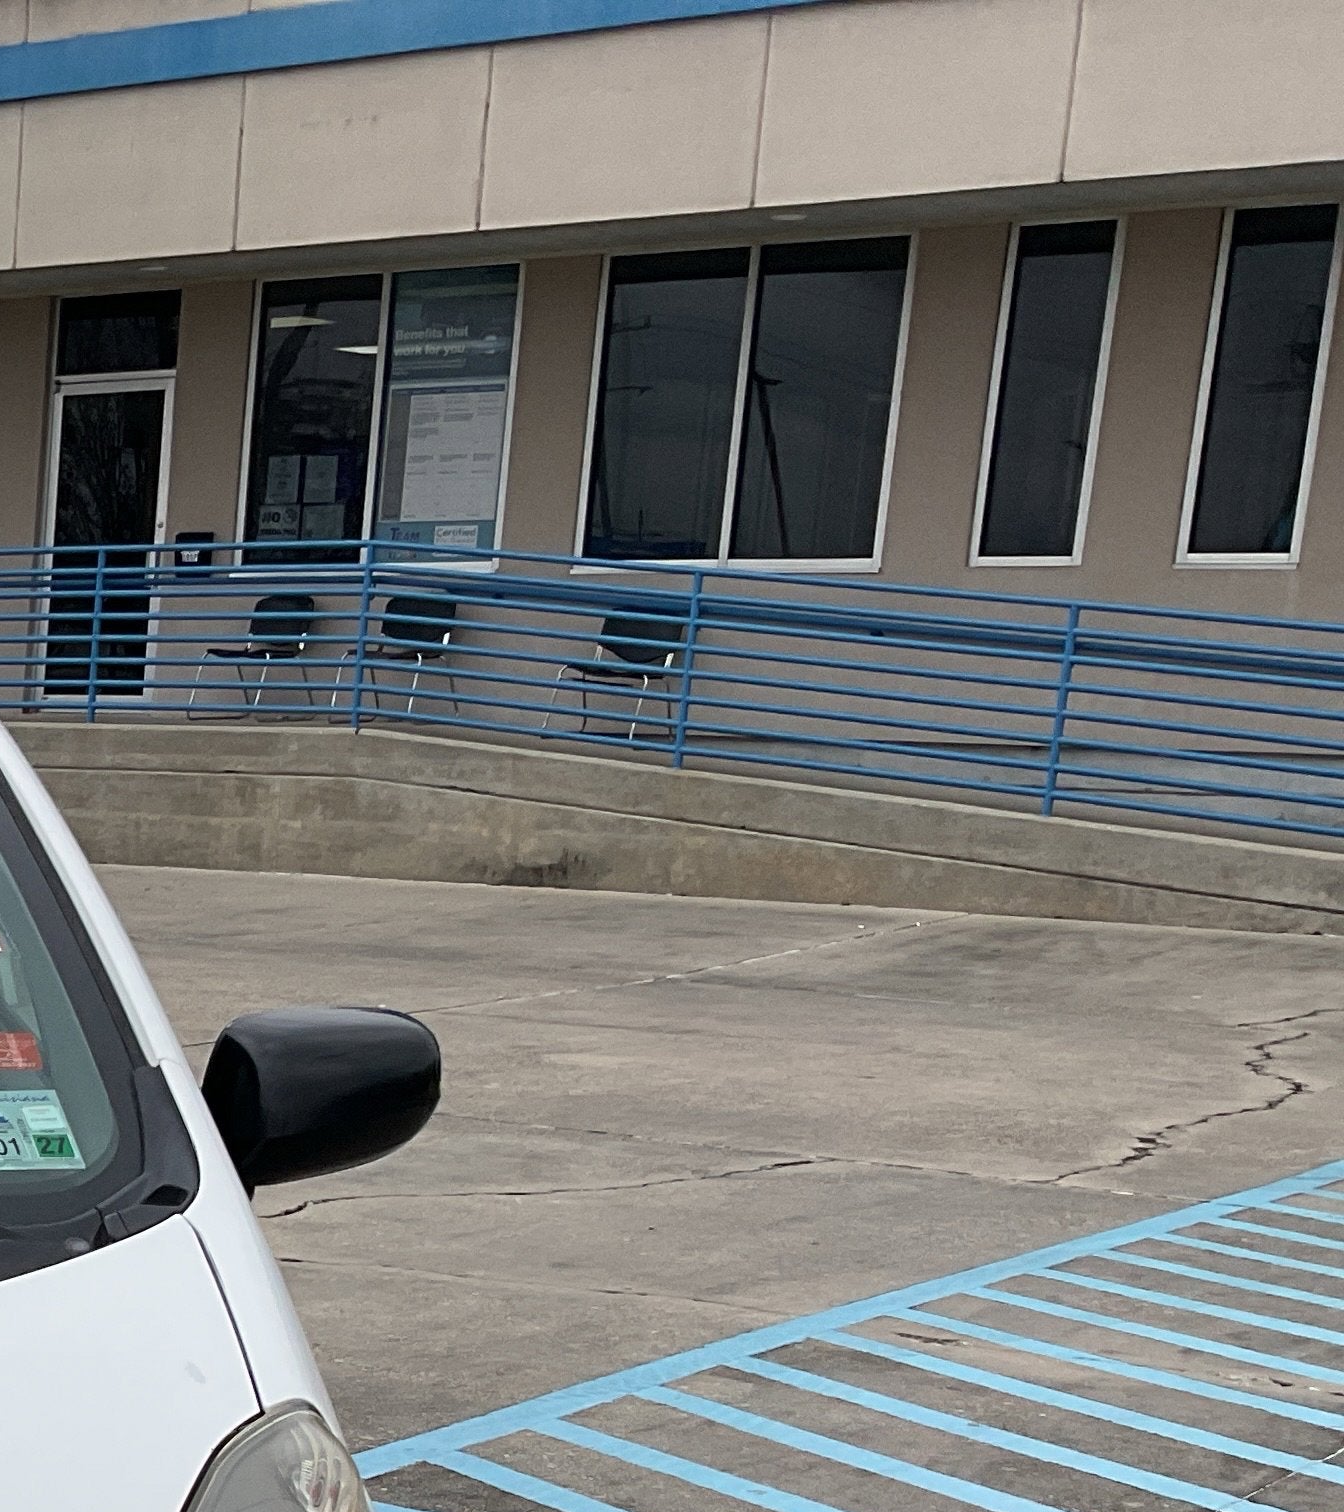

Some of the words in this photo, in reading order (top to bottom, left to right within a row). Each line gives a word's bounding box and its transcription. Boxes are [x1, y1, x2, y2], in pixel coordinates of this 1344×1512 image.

[395, 328, 443, 341] Benefits
[446, 325, 469, 338] that
[393, 345, 423, 356] work
[425, 343, 440, 354] for
[442, 344, 466, 357] you
[436, 526, 477, 538] Certified
[37, 1136, 65, 1155] 27
